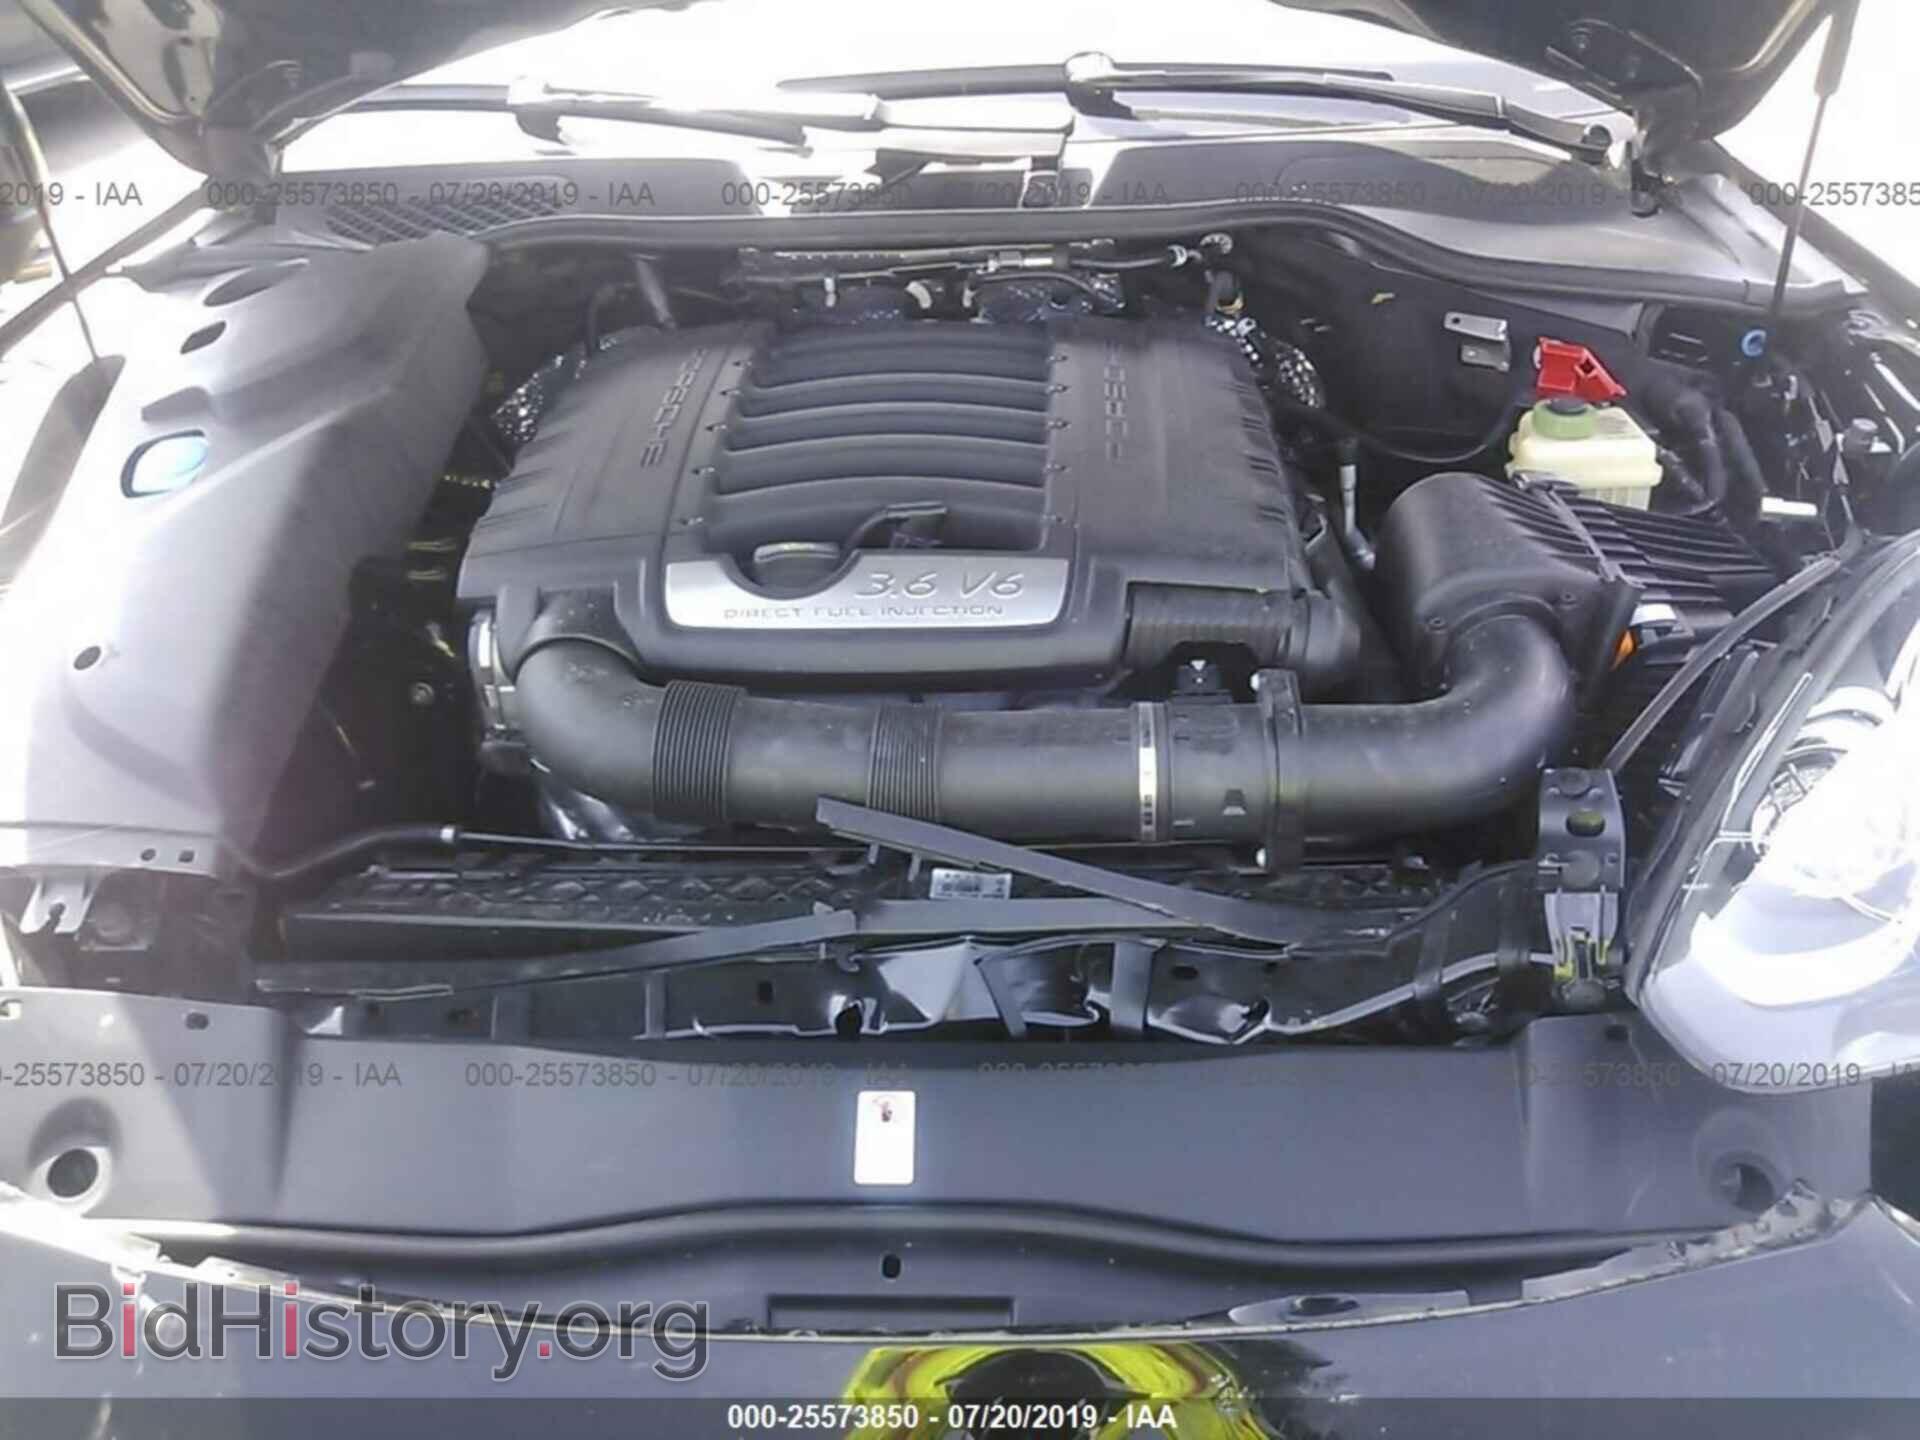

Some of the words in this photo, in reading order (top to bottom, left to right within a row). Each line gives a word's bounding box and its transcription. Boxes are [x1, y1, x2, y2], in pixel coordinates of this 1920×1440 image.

[854, 570, 938, 599] 3.6
[959, 570, 1025, 599] V6
[723, 606, 801, 620] DIRECT
[813, 605, 868, 618] FUEL
[880, 604, 1004, 617] INJECTION
